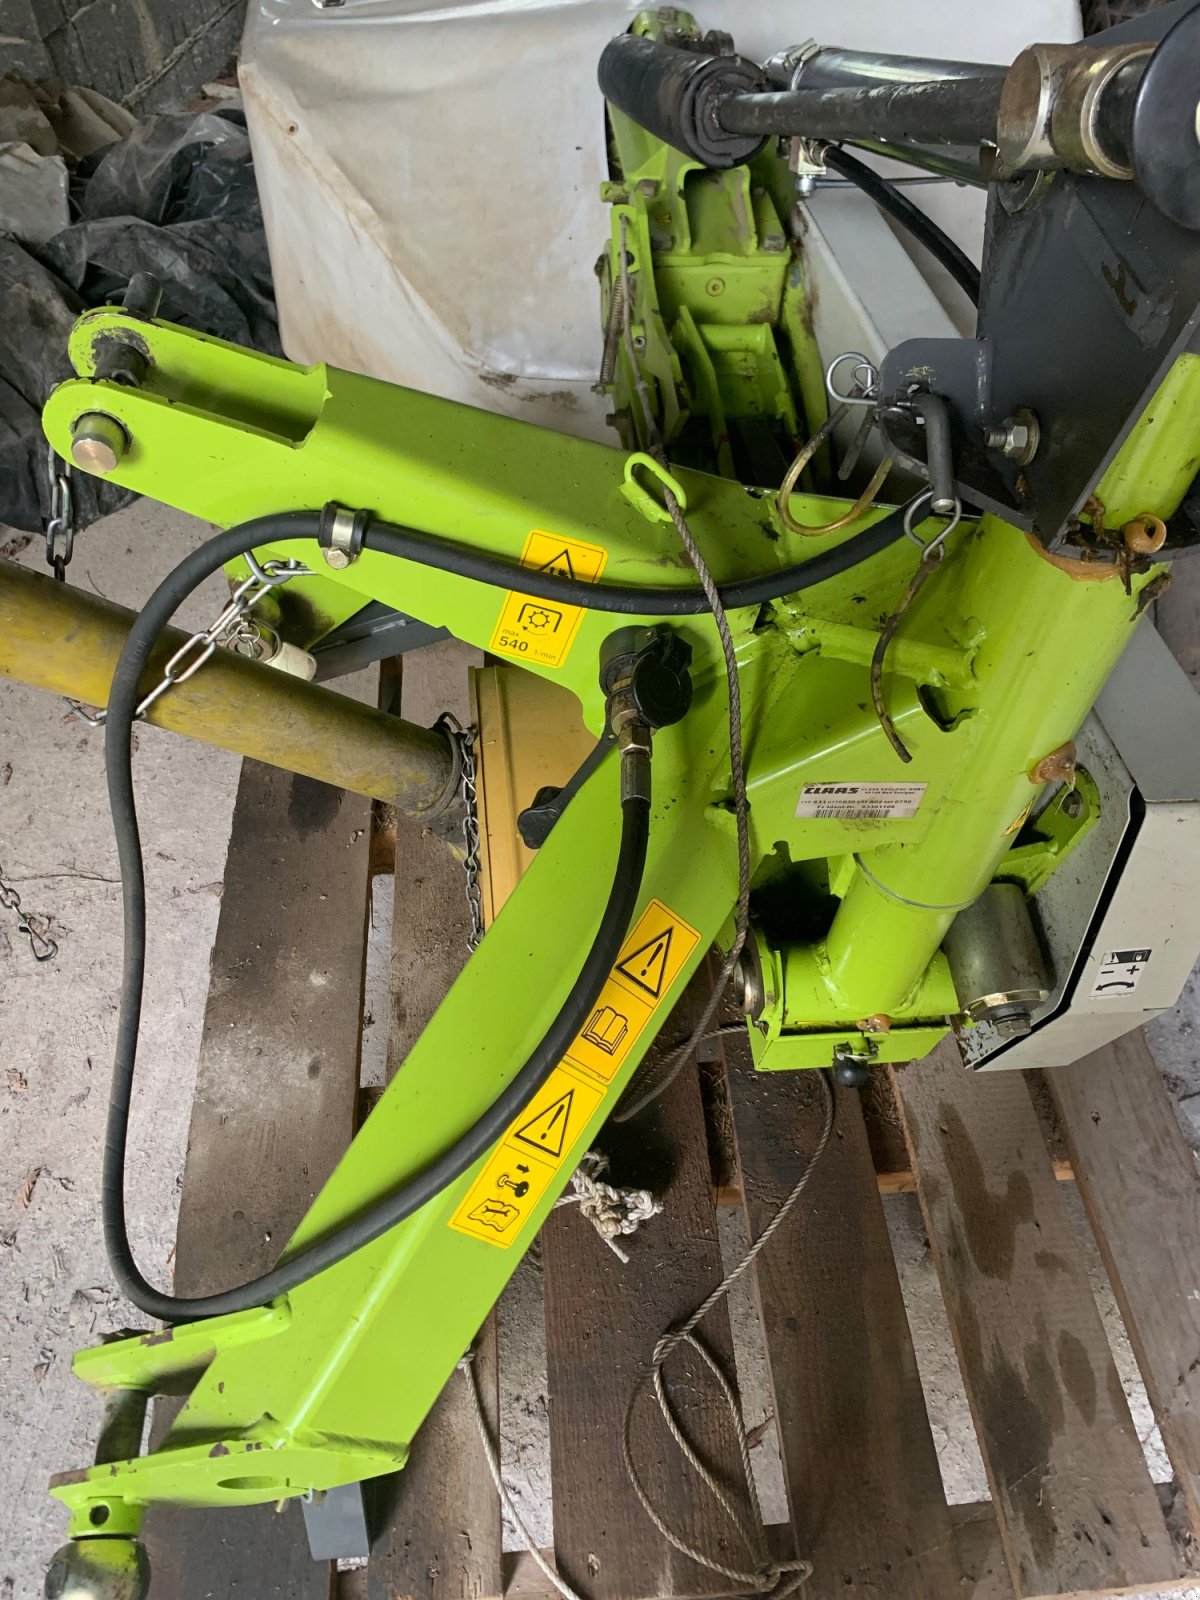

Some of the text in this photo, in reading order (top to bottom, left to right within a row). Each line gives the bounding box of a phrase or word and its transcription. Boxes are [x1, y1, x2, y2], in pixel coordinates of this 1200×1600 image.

[502, 628, 520, 637] max
[498, 636, 529, 652] 540
[804, 787, 860, 795] CLAAS
